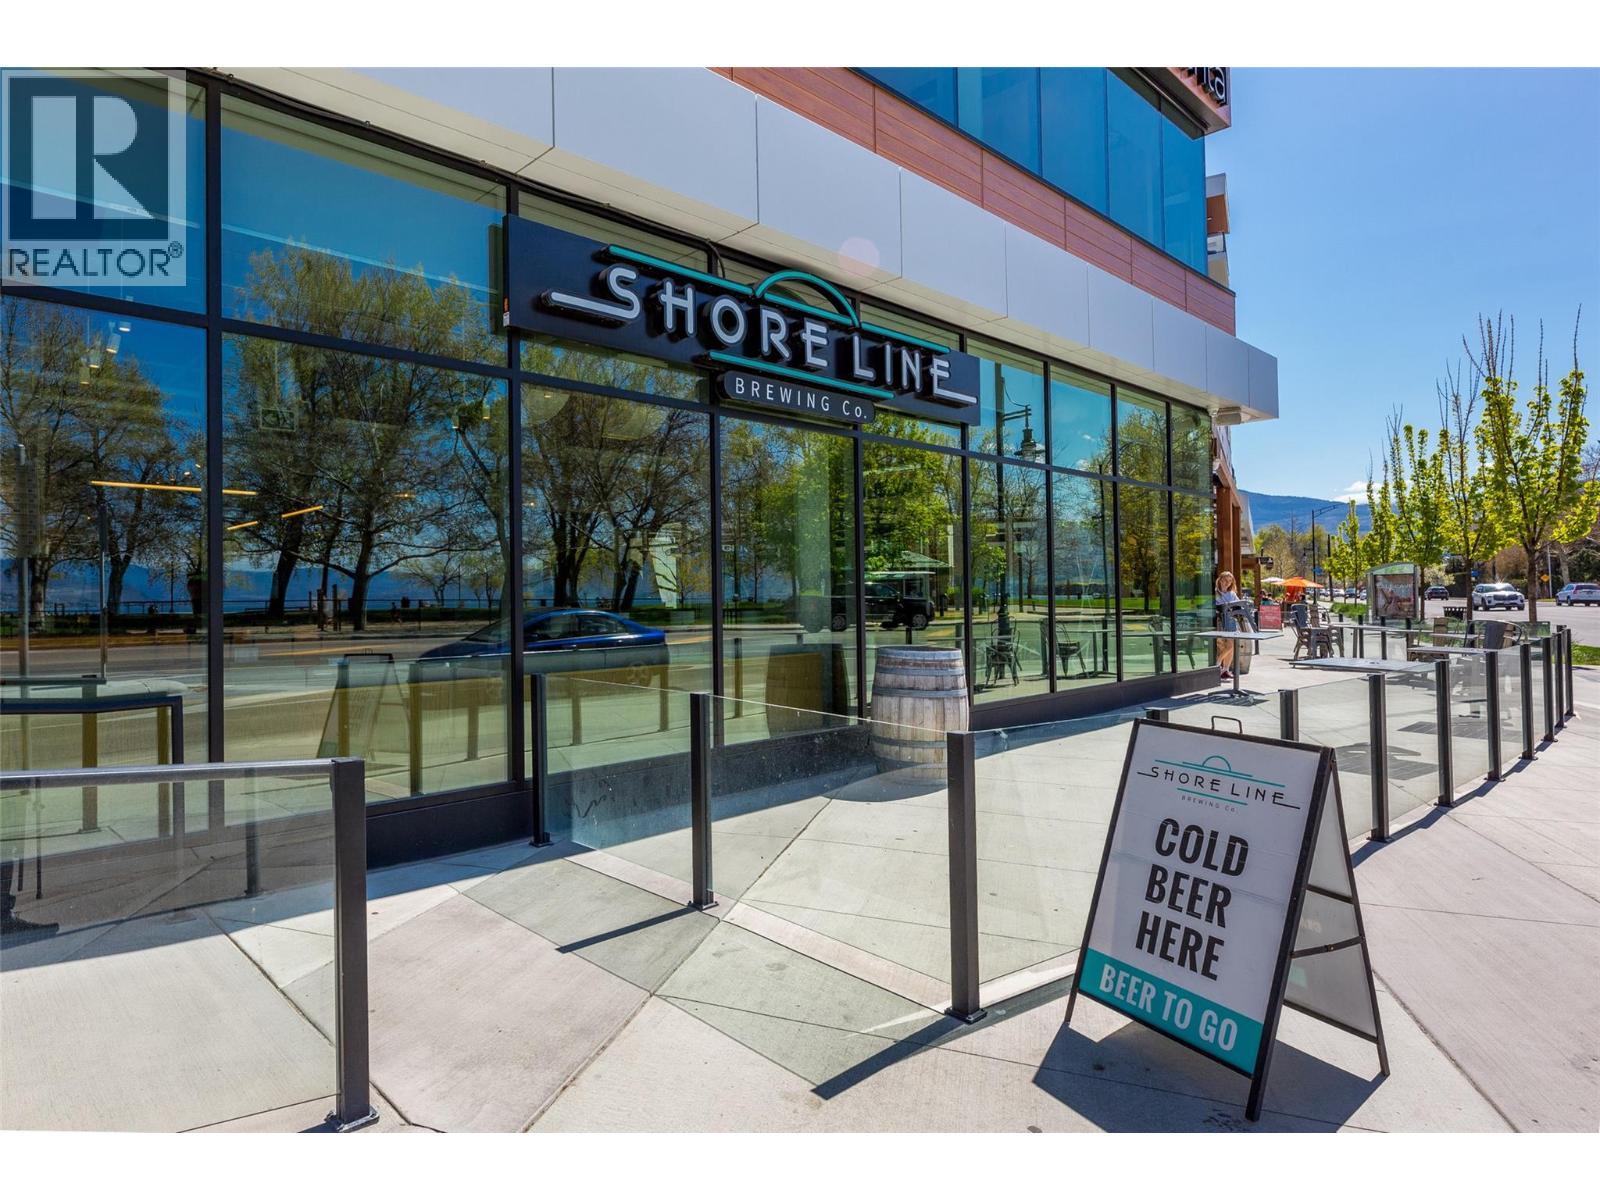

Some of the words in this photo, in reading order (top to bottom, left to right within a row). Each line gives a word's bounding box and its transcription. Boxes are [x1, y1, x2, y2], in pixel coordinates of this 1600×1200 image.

[550, 267, 829, 369] SHORE
[852, 334, 978, 405] LINE
[735, 377, 830, 412] BREWING
[842, 400, 867, 419] Co.
[1137, 766, 1222, 793] SHORE
[1230, 782, 1301, 810] LINE
[1181, 794, 1220, 809] BREWING
[1154, 817, 1249, 877] COLD
[1144, 863, 1232, 929] BEER
[1135, 910, 1225, 982] HERE
[1098, 963, 1157, 1014] BEER
[1161, 989, 1193, 1031] TO
[1199, 1009, 1239, 1052] GO
